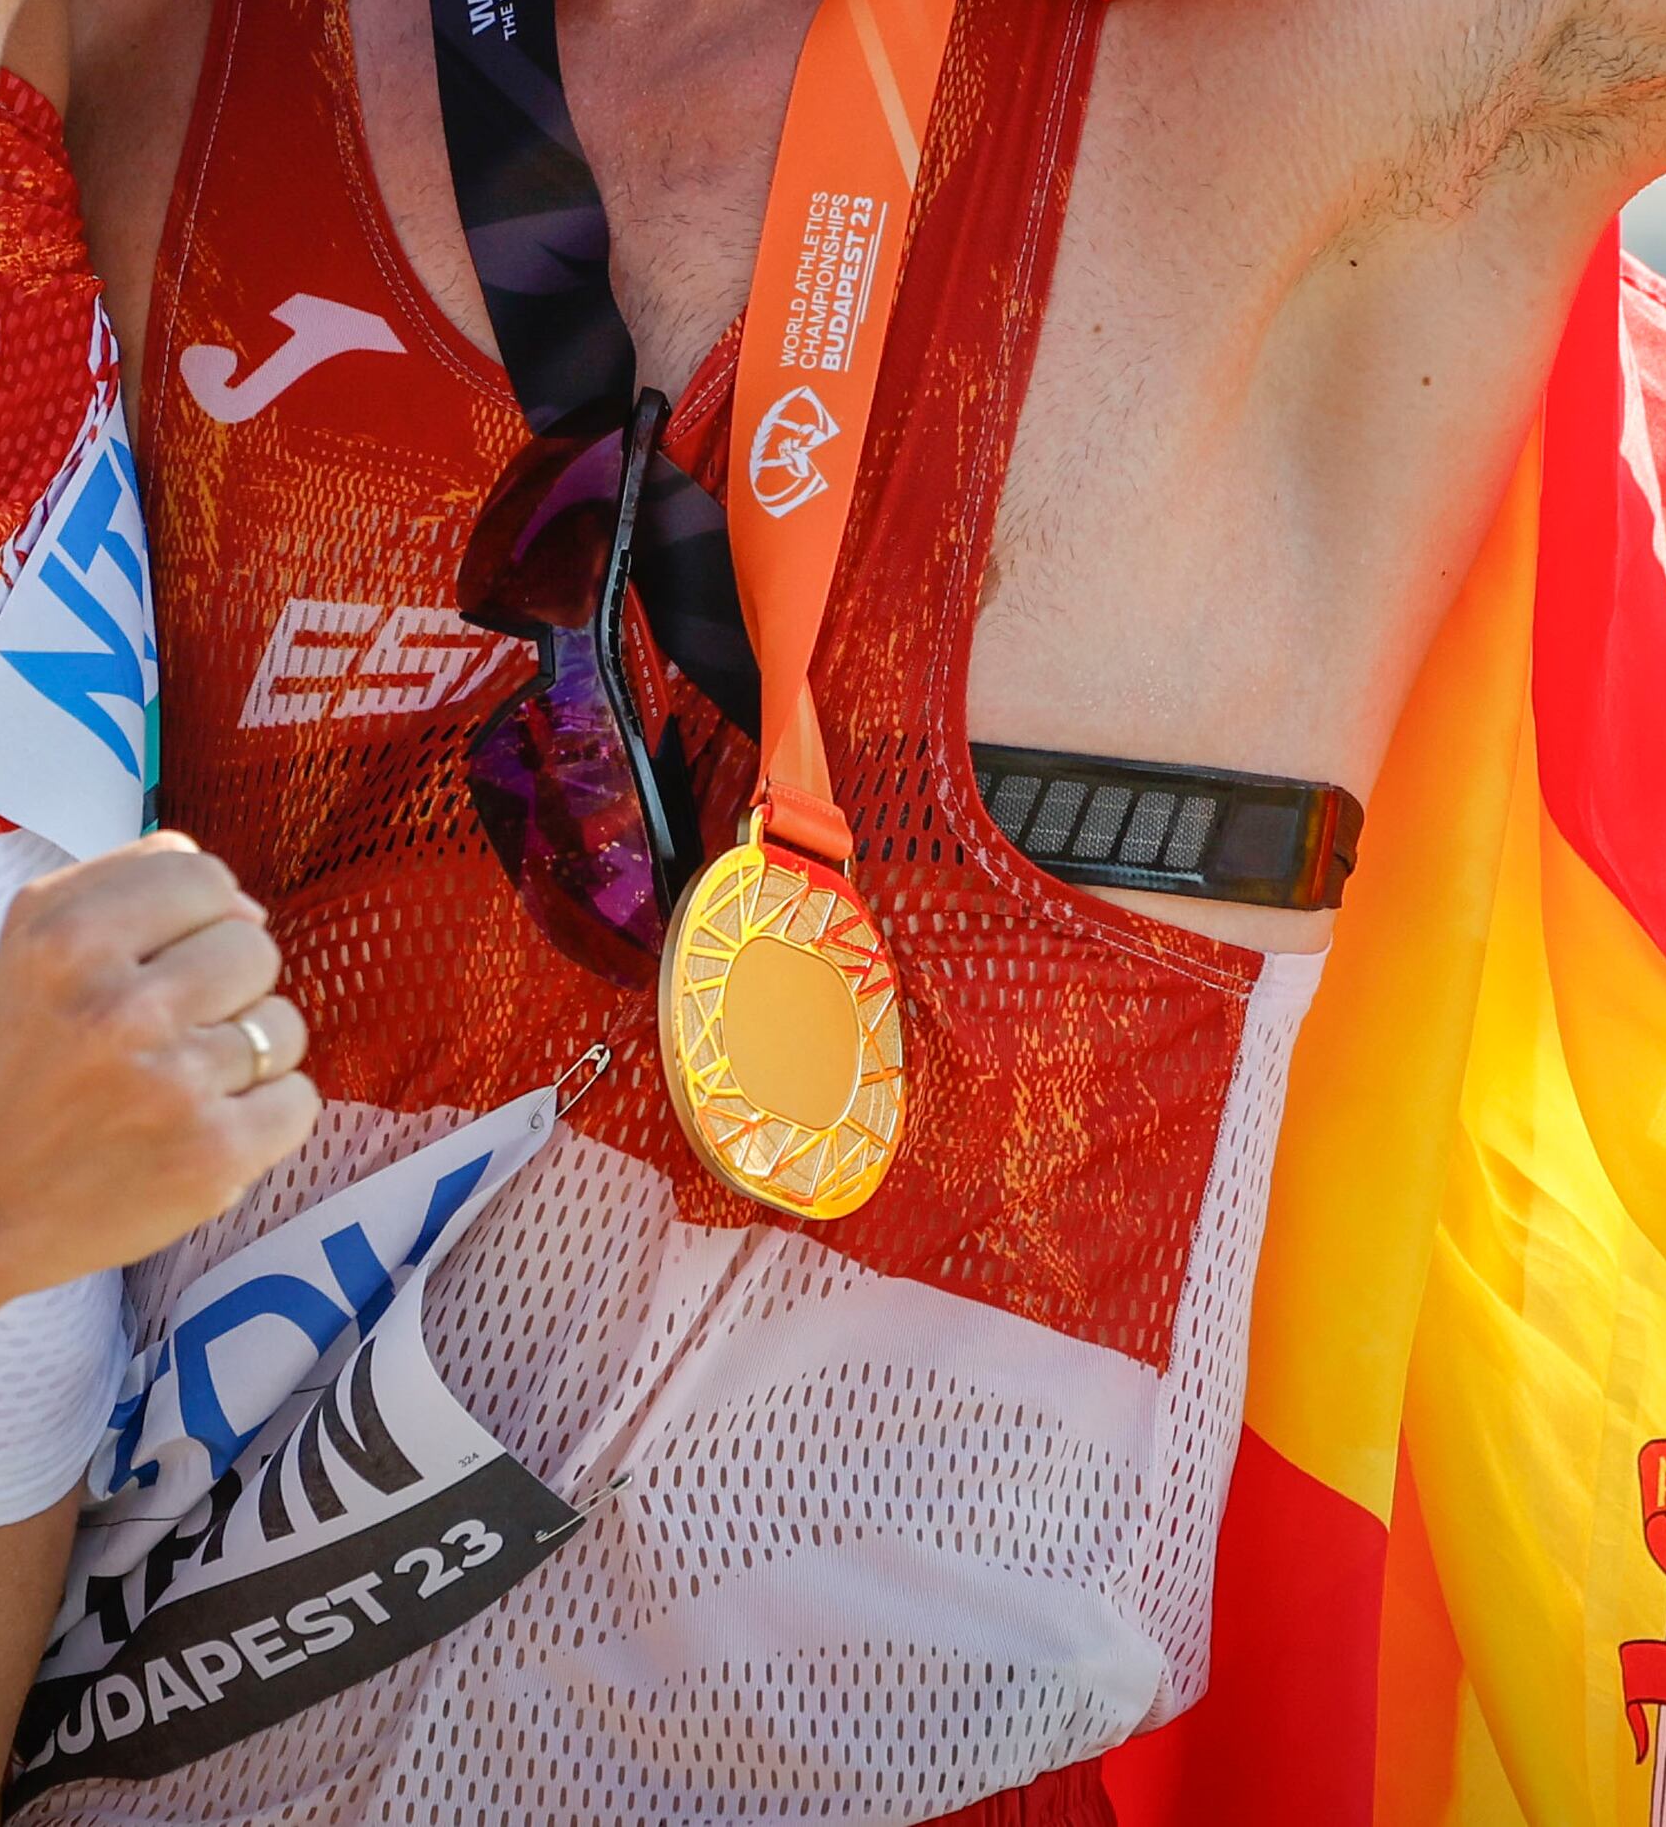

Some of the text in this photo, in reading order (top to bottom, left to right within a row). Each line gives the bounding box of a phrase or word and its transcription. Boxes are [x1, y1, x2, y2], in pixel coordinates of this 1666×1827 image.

[500, 3, 517, 41] THE
[780, 191, 829, 367] WORLD ATHLETICS
[799, 194, 850, 369] CHAMPIONSHIPS
[821, 197, 873, 371] BUDAPEST 23
[457, 1451, 480, 1468] 324
[393, 1519, 504, 1600] 23
